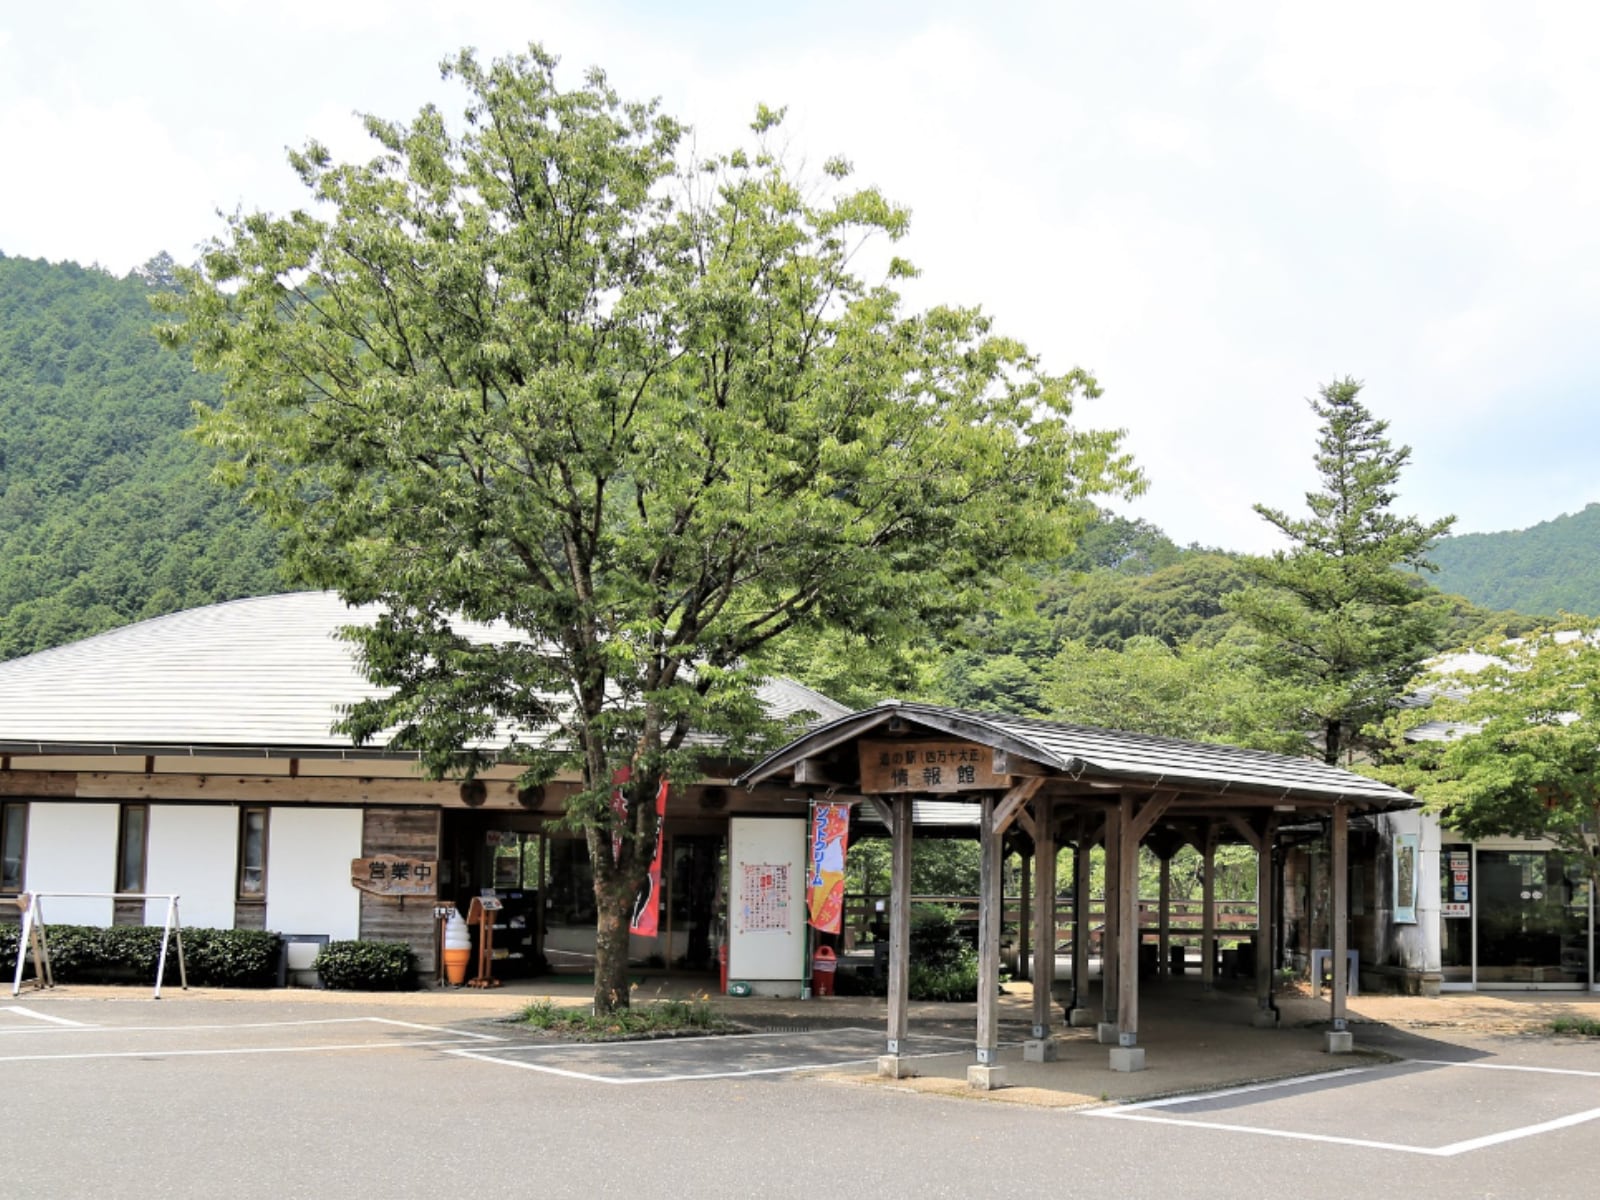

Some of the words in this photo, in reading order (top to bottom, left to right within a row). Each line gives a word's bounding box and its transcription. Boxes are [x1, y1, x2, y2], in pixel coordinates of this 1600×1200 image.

[891, 765, 975, 786] 情報館
[812, 807, 829, 886] ソフトクリーム
[369, 861, 431, 880] 営業中
